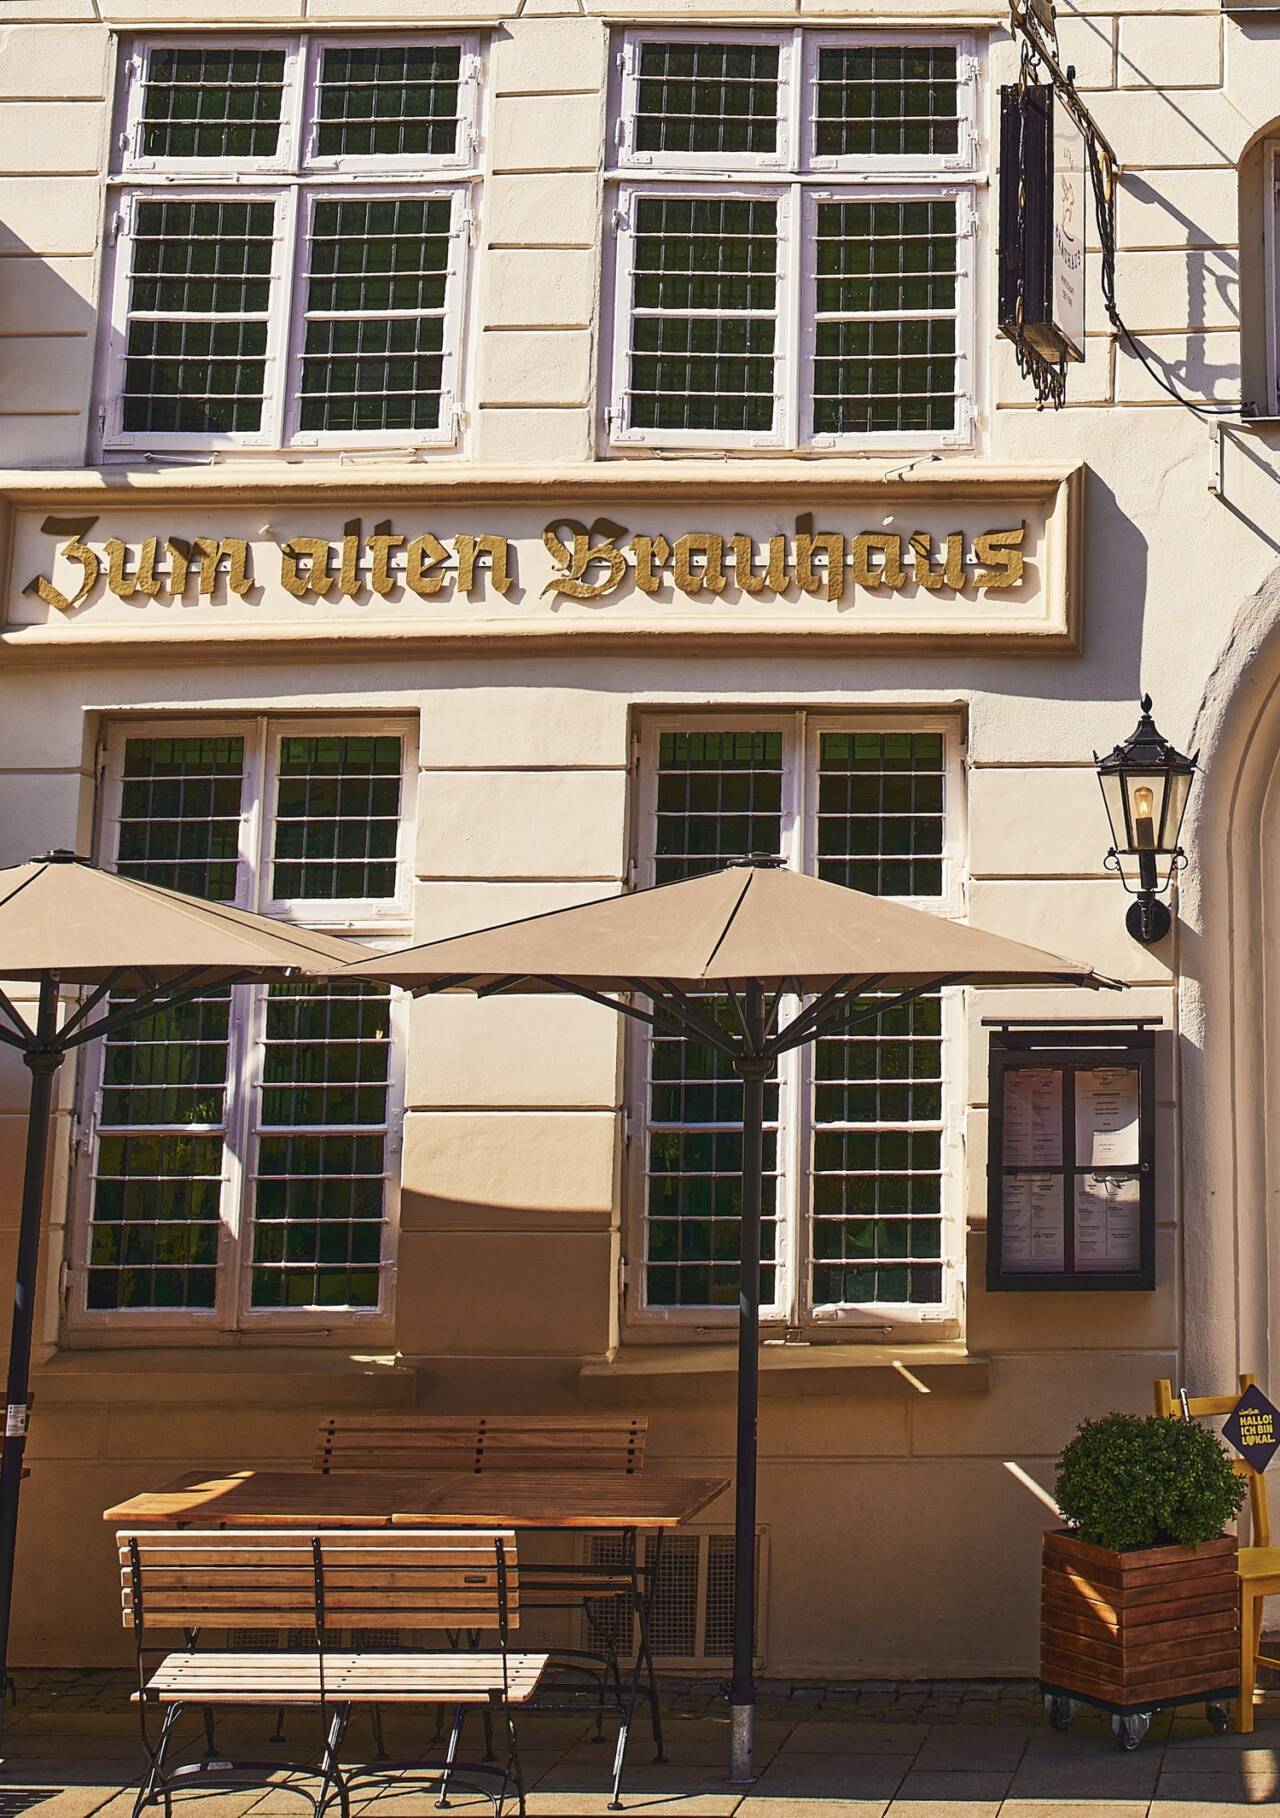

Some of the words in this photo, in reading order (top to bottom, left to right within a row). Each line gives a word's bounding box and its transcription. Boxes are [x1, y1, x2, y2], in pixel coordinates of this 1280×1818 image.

[22, 515, 256, 612] Zum
[281, 517, 513, 597] alten
[539, 512, 1025, 603] Brauhaus
[1240, 1414, 1273, 1426] HALLO!
[1240, 1426, 1256, 1435] ICH
[1257, 1424, 1273, 1434] BIN
